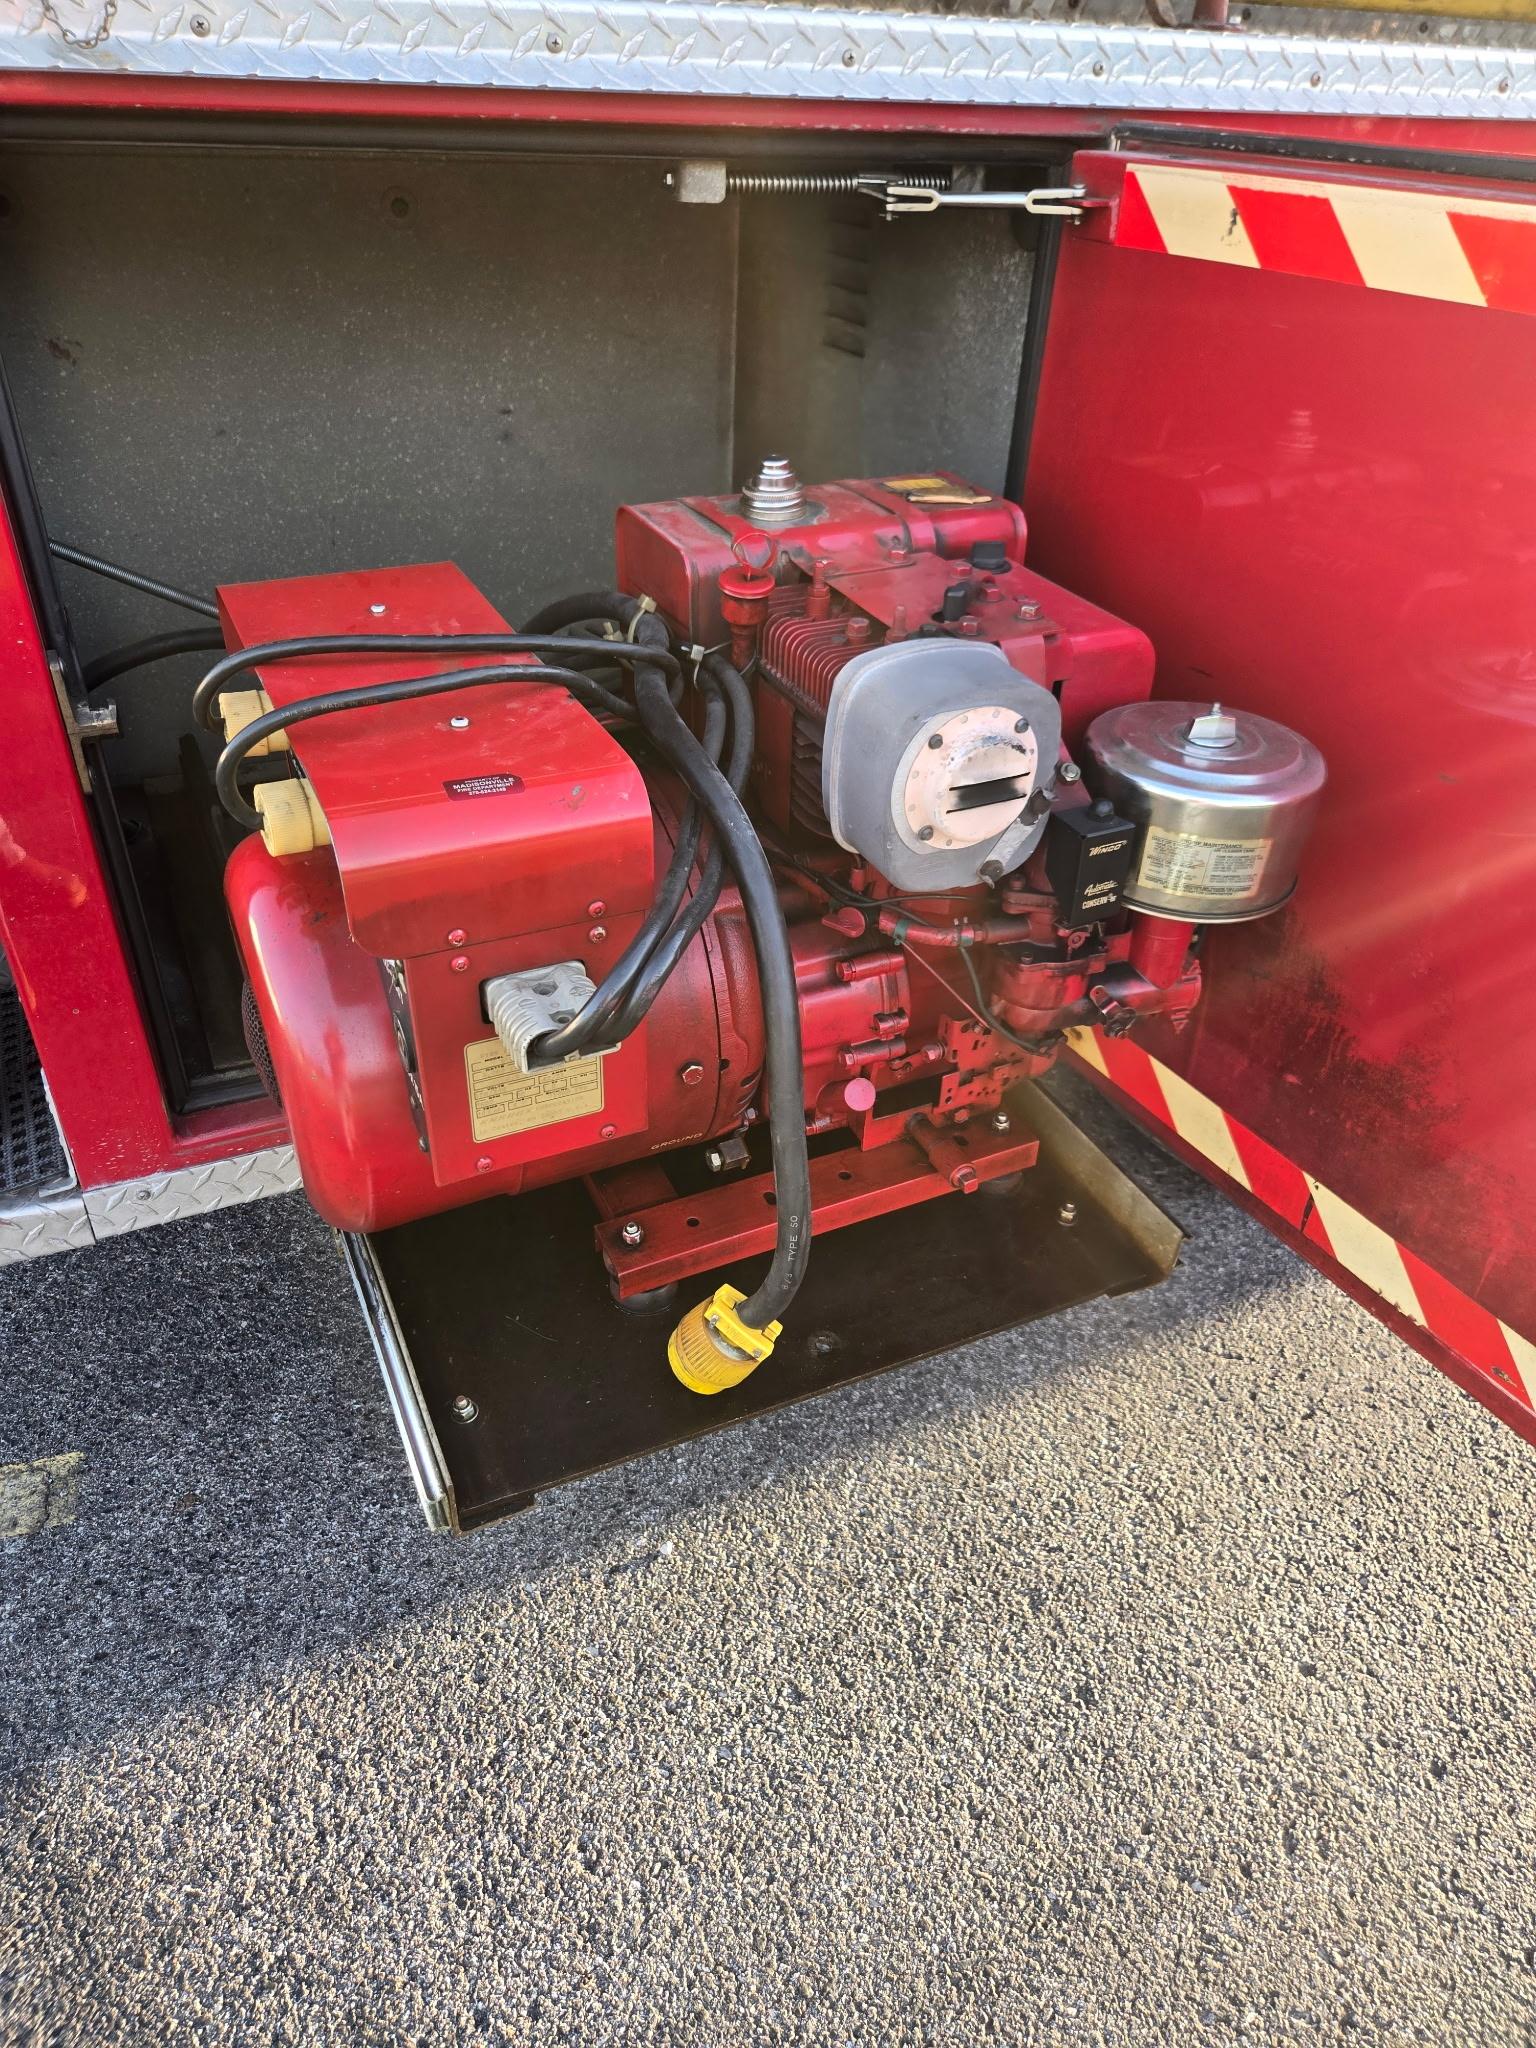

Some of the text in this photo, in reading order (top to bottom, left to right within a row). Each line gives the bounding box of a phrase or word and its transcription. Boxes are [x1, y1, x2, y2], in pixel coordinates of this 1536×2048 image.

[320, 702, 345, 711] MADE
[453, 778, 515, 789] MADISONVILLE
[472, 782, 514, 792] DEPARTMENT
[651, 1133, 703, 1149] GROUND
[787, 1234, 798, 1262] TYPE
